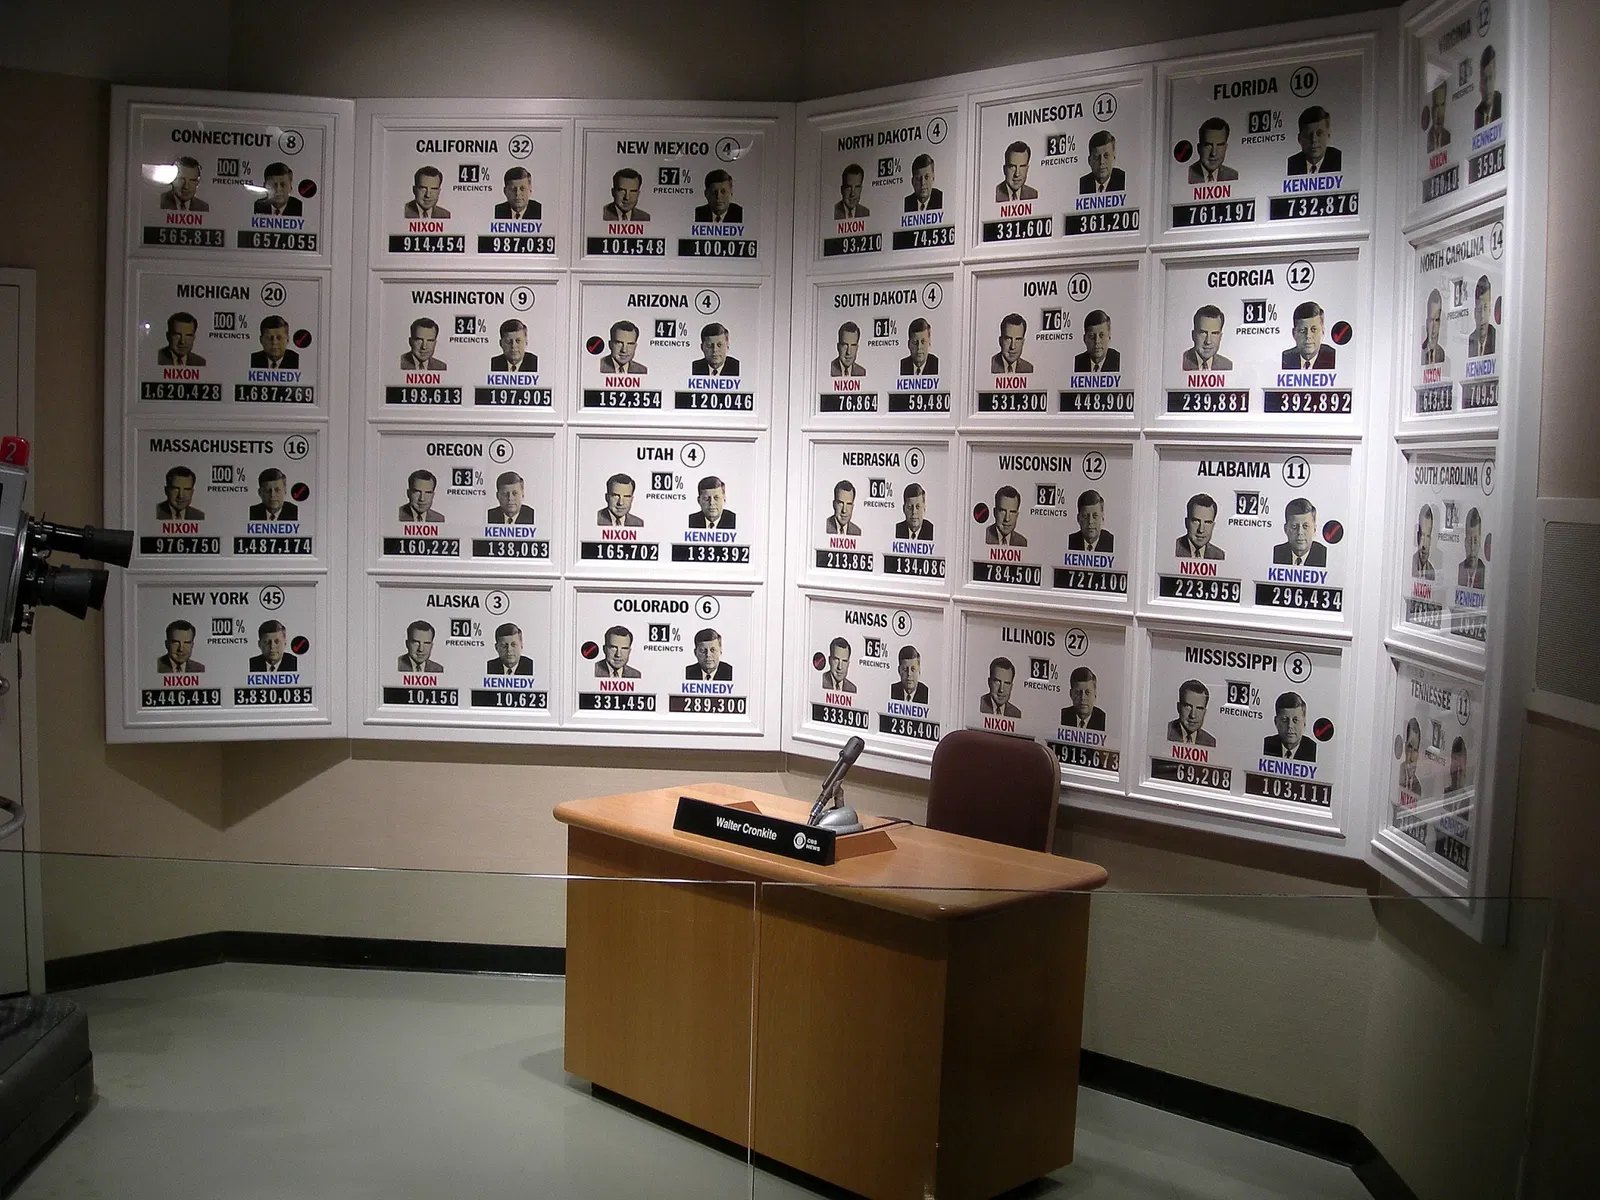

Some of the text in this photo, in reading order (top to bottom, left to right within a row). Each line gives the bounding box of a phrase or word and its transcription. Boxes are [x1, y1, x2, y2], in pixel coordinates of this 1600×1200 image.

[1214, 72, 1314, 100] FLORIDA 10
[1008, 99, 1113, 127] MINNESOTA 11
[172, 129, 296, 148] CONNECTICUT 8
[838, 124, 940, 151] NORTH DAKOTA 4
[1472, 122, 1504, 150] KENNEDY
[416, 140, 529, 153] CALIFORNIA 32
[617, 141, 732, 155] NEW MEXICO 4
[1001, 203, 1032, 217] NIXON
[1076, 194, 1126, 210] KENNEDY
[1288, 195, 1358, 217] 732,876
[167, 213, 202, 225] NIXON
[1189, 203, 1254, 224] 761,197
[252, 217, 304, 230] KENNEDY
[609, 224, 644, 234] NIXON
[997, 219, 1052, 240] 331,600
[1081, 212, 1138, 232] 361,200
[160, 229, 222, 245] 565,813
[692, 226, 744, 236] KENNEDY
[914, 229, 954, 246] 74,536
[253, 232, 315, 249] 657,055
[404, 237, 463, 252] 914,454
[494, 238, 554, 252] 987,039
[602, 239, 664, 254] 101,548
[694, 241, 755, 256] 100,076
[843, 235, 882, 253] 93,210
[1420, 231, 1503, 273] NORTH CAROLINA 14
[1208, 268, 1310, 287] GEORGIA 12
[177, 285, 282, 301] MICHIGAN 20
[1024, 279, 1087, 296] IOWA 10
[412, 291, 527, 304] WASHINGTON 9
[628, 294, 711, 308] ARIZONA 4
[834, 288, 936, 308] SOUTH DAKOTA 4
[1466, 359, 1496, 377] KENNEDY
[407, 374, 440, 384] NIXON
[488, 375, 539, 385] KENNEDY
[834, 380, 860, 391] NIXON
[897, 378, 939, 390] KENNEDY
[1188, 375, 1225, 387] NIXON
[1278, 374, 1337, 387] KENNEDY
[144, 384, 219, 400] 1,620,428
[239, 386, 312, 402] 1,687,269
[401, 389, 460, 404] 198,613
[490, 390, 550, 405] 197,905
[600, 392, 660, 407] 152,354
[691, 394, 752, 409] 120,046
[839, 396, 877, 411] 76,864
[909, 394, 950, 410] 59,480
[992, 394, 1047, 411] 531,300
[1075, 393, 1133, 411] 448,900
[1183, 393, 1247, 412] 239,881
[1281, 393, 1350, 412] 392,892
[6, 443, 17, 461] 2
[150, 439, 305, 454] MASSACHUSETTS 16
[427, 443, 505, 457] OREGON 6
[637, 448, 697, 461] UTAH 4
[843, 452, 918, 467] NEBRASKA 6
[999, 456, 1102, 472] WISCONSIN 12
[1198, 461, 1305, 479] ALABAMA 11
[1415, 467, 1491, 485] SOUTH CAROLINA 8
[163, 523, 198, 533] NIXON
[247, 524, 299, 534] KENNEDY
[602, 530, 636, 540] NIXON
[685, 532, 737, 543] KENNEDY
[156, 539, 218, 553] 976,750
[238, 539, 310, 553] 1,487,174
[400, 540, 458, 555] 160,222
[488, 542, 547, 556] 138,063
[598, 544, 657, 560] 165,702
[688, 547, 748, 562] 133,392
[827, 552, 873, 570] 213,865
[990, 549, 1021, 561] NIXON
[1064, 553, 1114, 568] KENNEDY
[897, 558, 945, 576] 134,086
[987, 565, 1040, 584] 784,500
[1069, 571, 1126, 591] 727,100
[173, 592, 281, 605] NEW YORK 45
[1176, 580, 1239, 601] 223,959
[1273, 587, 1341, 609] 296,434
[427, 595, 502, 608] ALASKA 3
[614, 600, 711, 614] COLORADO 6
[845, 610, 905, 629] KANSAS 8
[1002, 627, 1085, 650] ILLINOIS 27
[1185, 647, 1303, 675] MISSISSIPPI 8
[404, 675, 437, 686] NIXON
[484, 678, 534, 688] KENNEDY
[145, 691, 219, 706] 3,446,419
[238, 689, 311, 704] 3,830,085
[408, 690, 457, 704] 10,156
[496, 692, 546, 706] 10,623
[594, 695, 654, 710] 331,450
[826, 693, 852, 706] NIXON
[1411, 680, 1468, 716] TENNESSEE 11
[684, 697, 745, 713] 289,300
[888, 702, 929, 718] KENNEDY
[824, 707, 868, 728] 333,900
[891, 719, 939, 739] 236,400
[1172, 745, 1208, 762] NIXON
[1177, 765, 1229, 788] 69,208
[1259, 759, 1318, 779] KENNEDY
[1263, 778, 1329, 804] 103,111
[716, 817, 777, 840] Walter Cronkite
